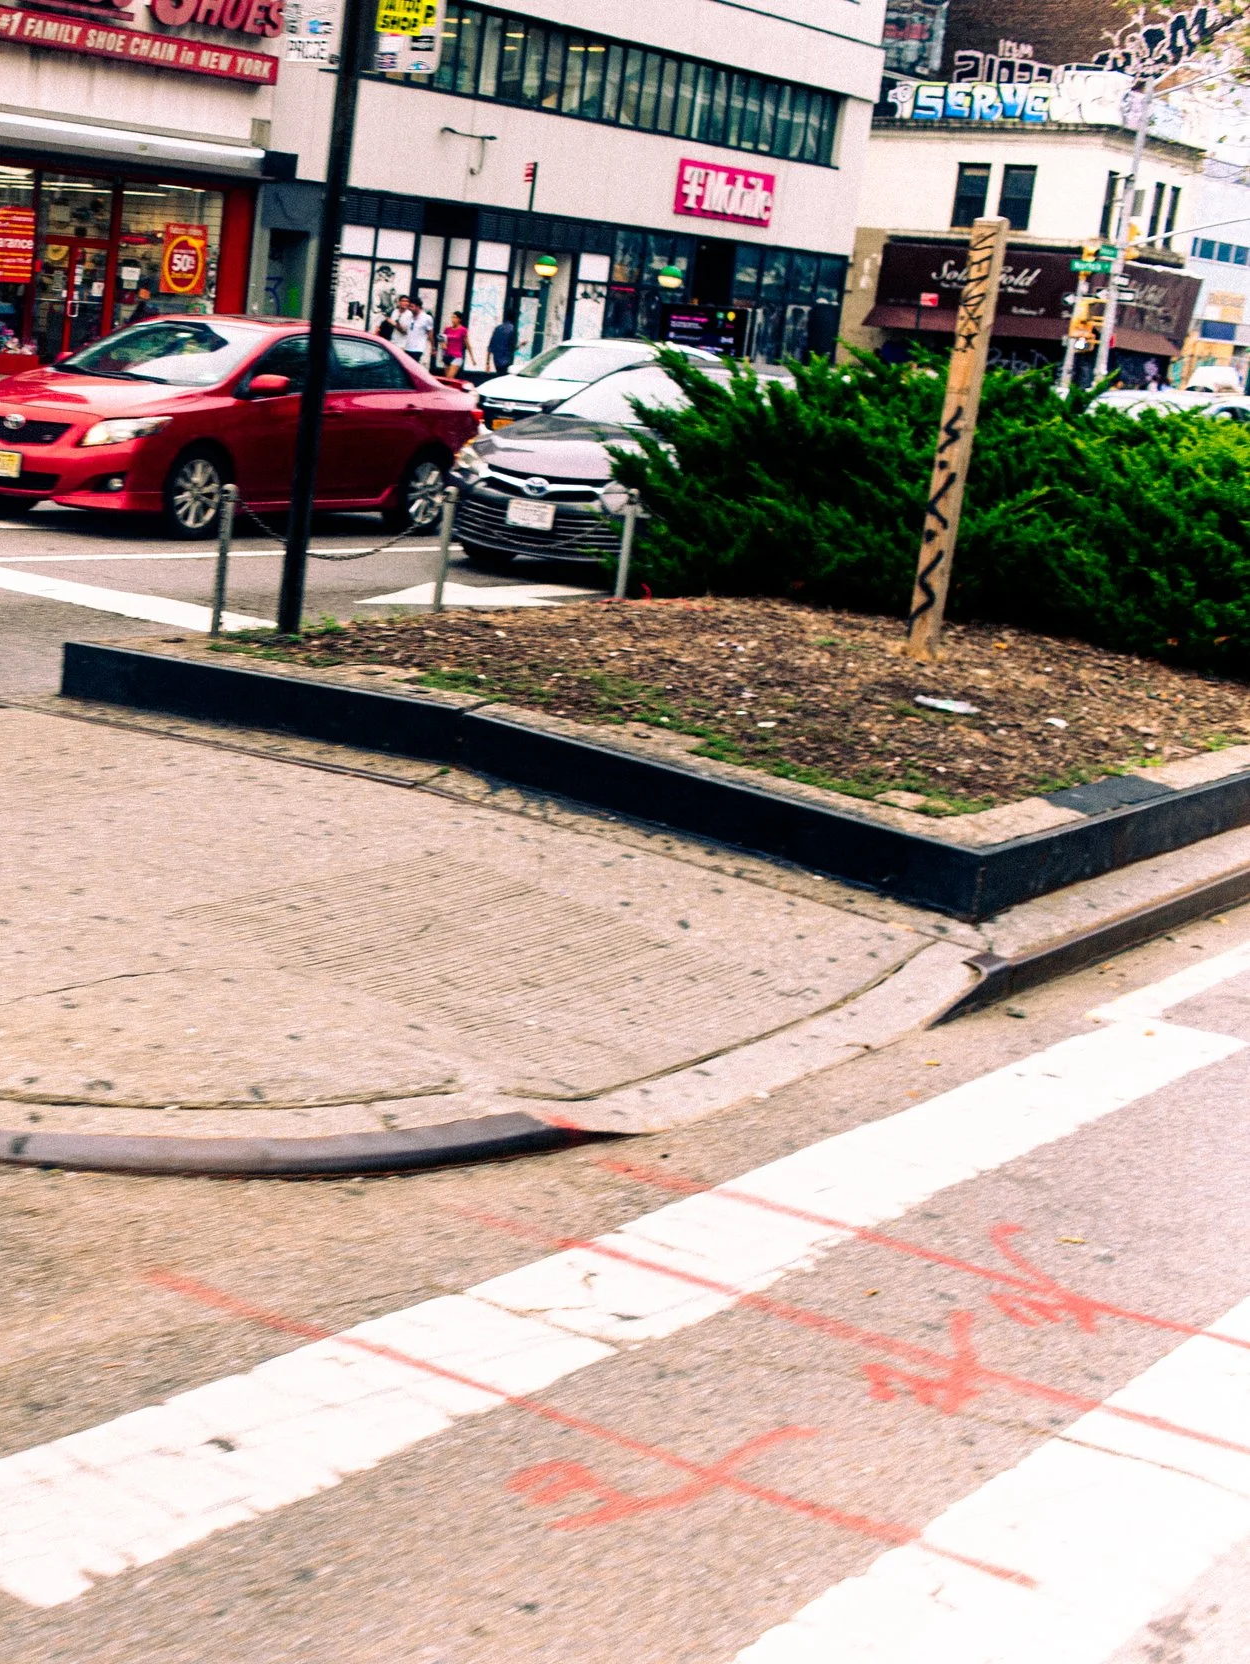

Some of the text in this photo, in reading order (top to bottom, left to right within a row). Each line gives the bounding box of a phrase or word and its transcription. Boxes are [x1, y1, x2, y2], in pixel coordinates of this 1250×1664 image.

[23, 17, 82, 45] FAMILY
[85, 28, 125, 53] SHOE
[129, 36, 178, 61] CHAIN
[179, 45, 196, 65] in
[199, 50, 233, 71] NEW
[236, 57, 273, 79] YORK
[913, 82, 1052, 122] SERVE
[930, 259, 969, 282] Sol
